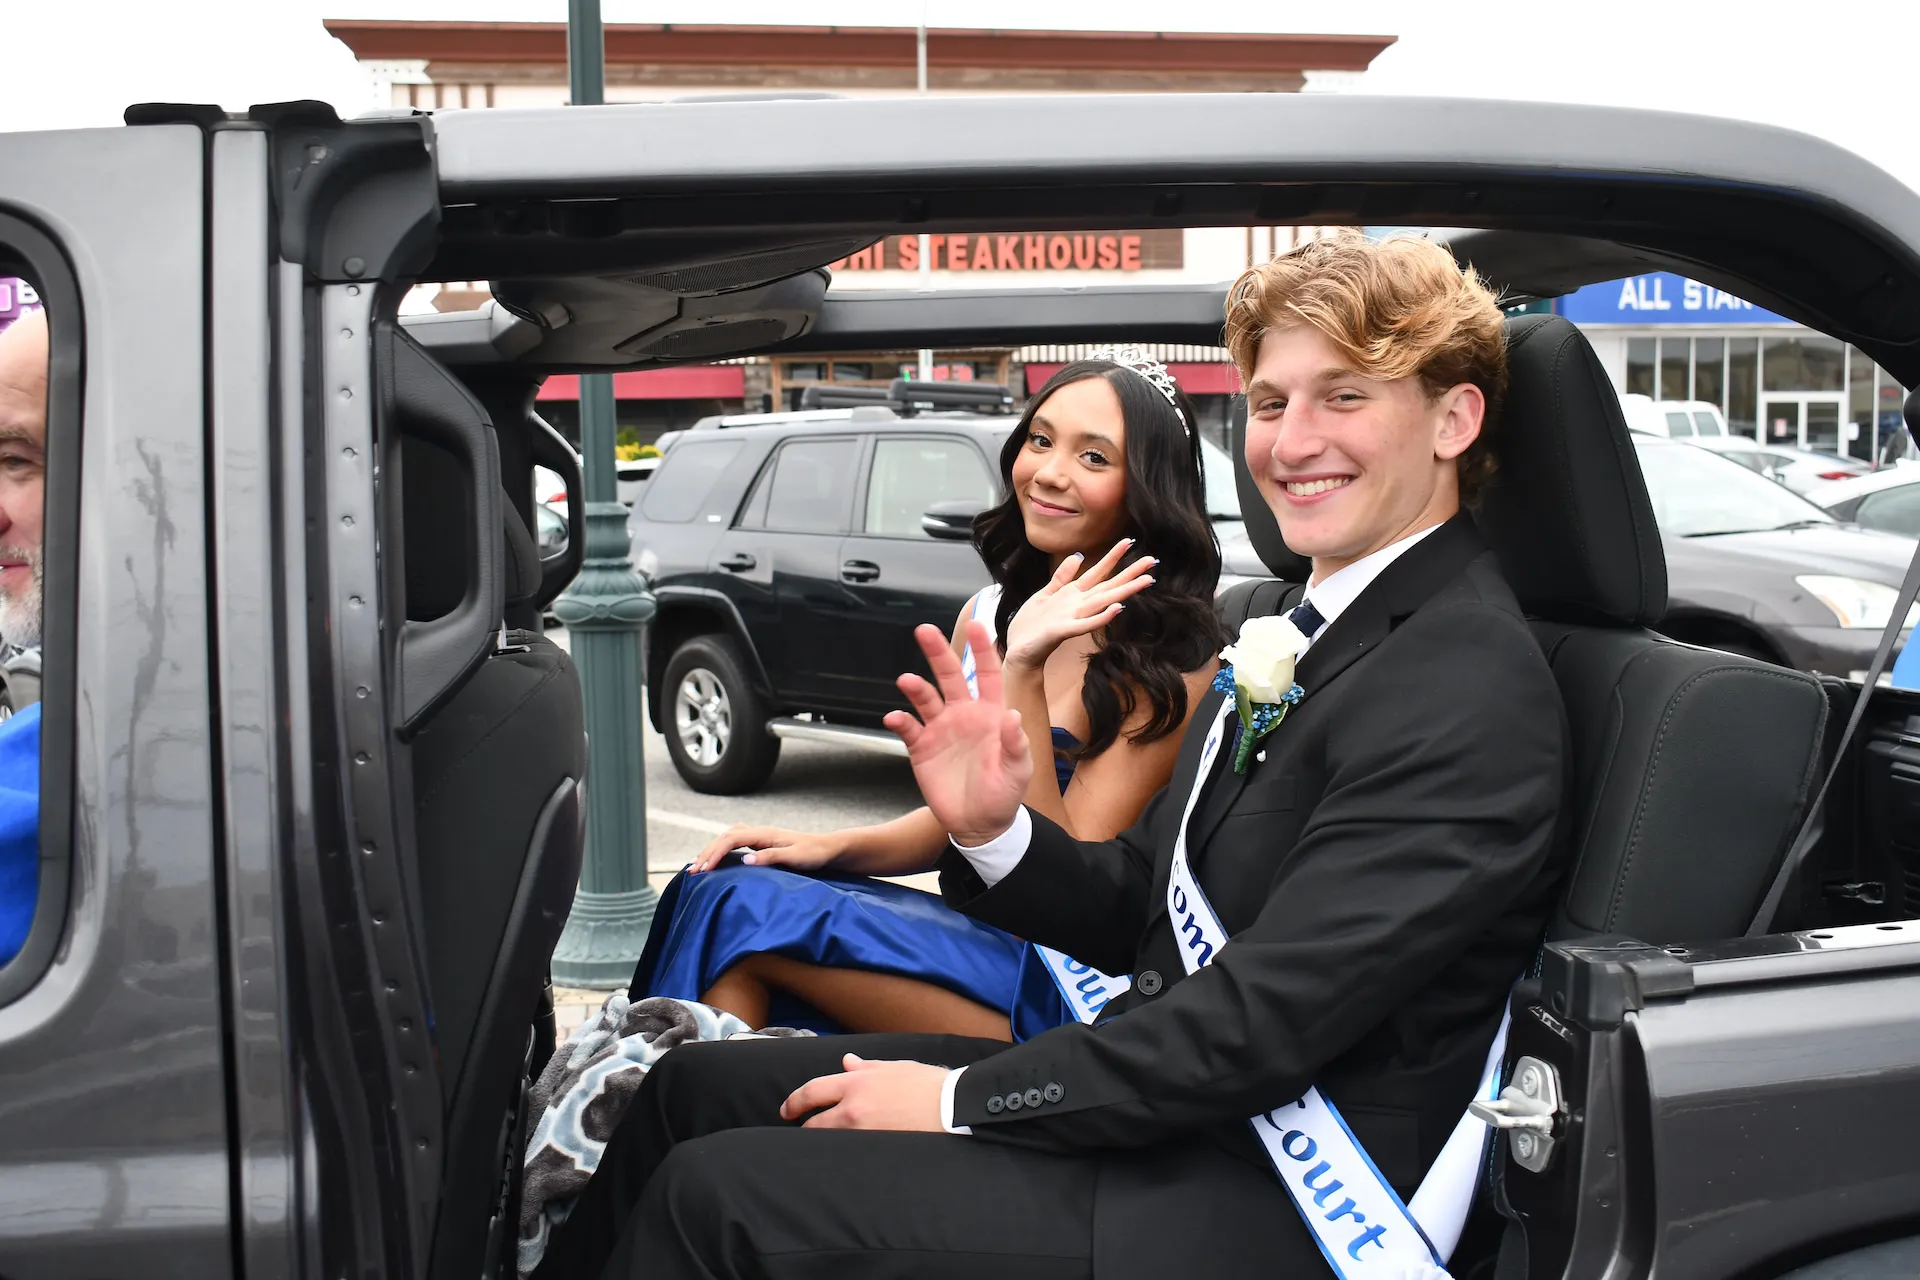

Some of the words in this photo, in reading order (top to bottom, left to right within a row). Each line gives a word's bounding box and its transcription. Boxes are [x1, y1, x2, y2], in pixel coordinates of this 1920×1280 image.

[829, 240, 884, 270] HI
[898, 235, 1142, 270] STEAKHOUSE
[1617, 277, 1671, 311] ALL
